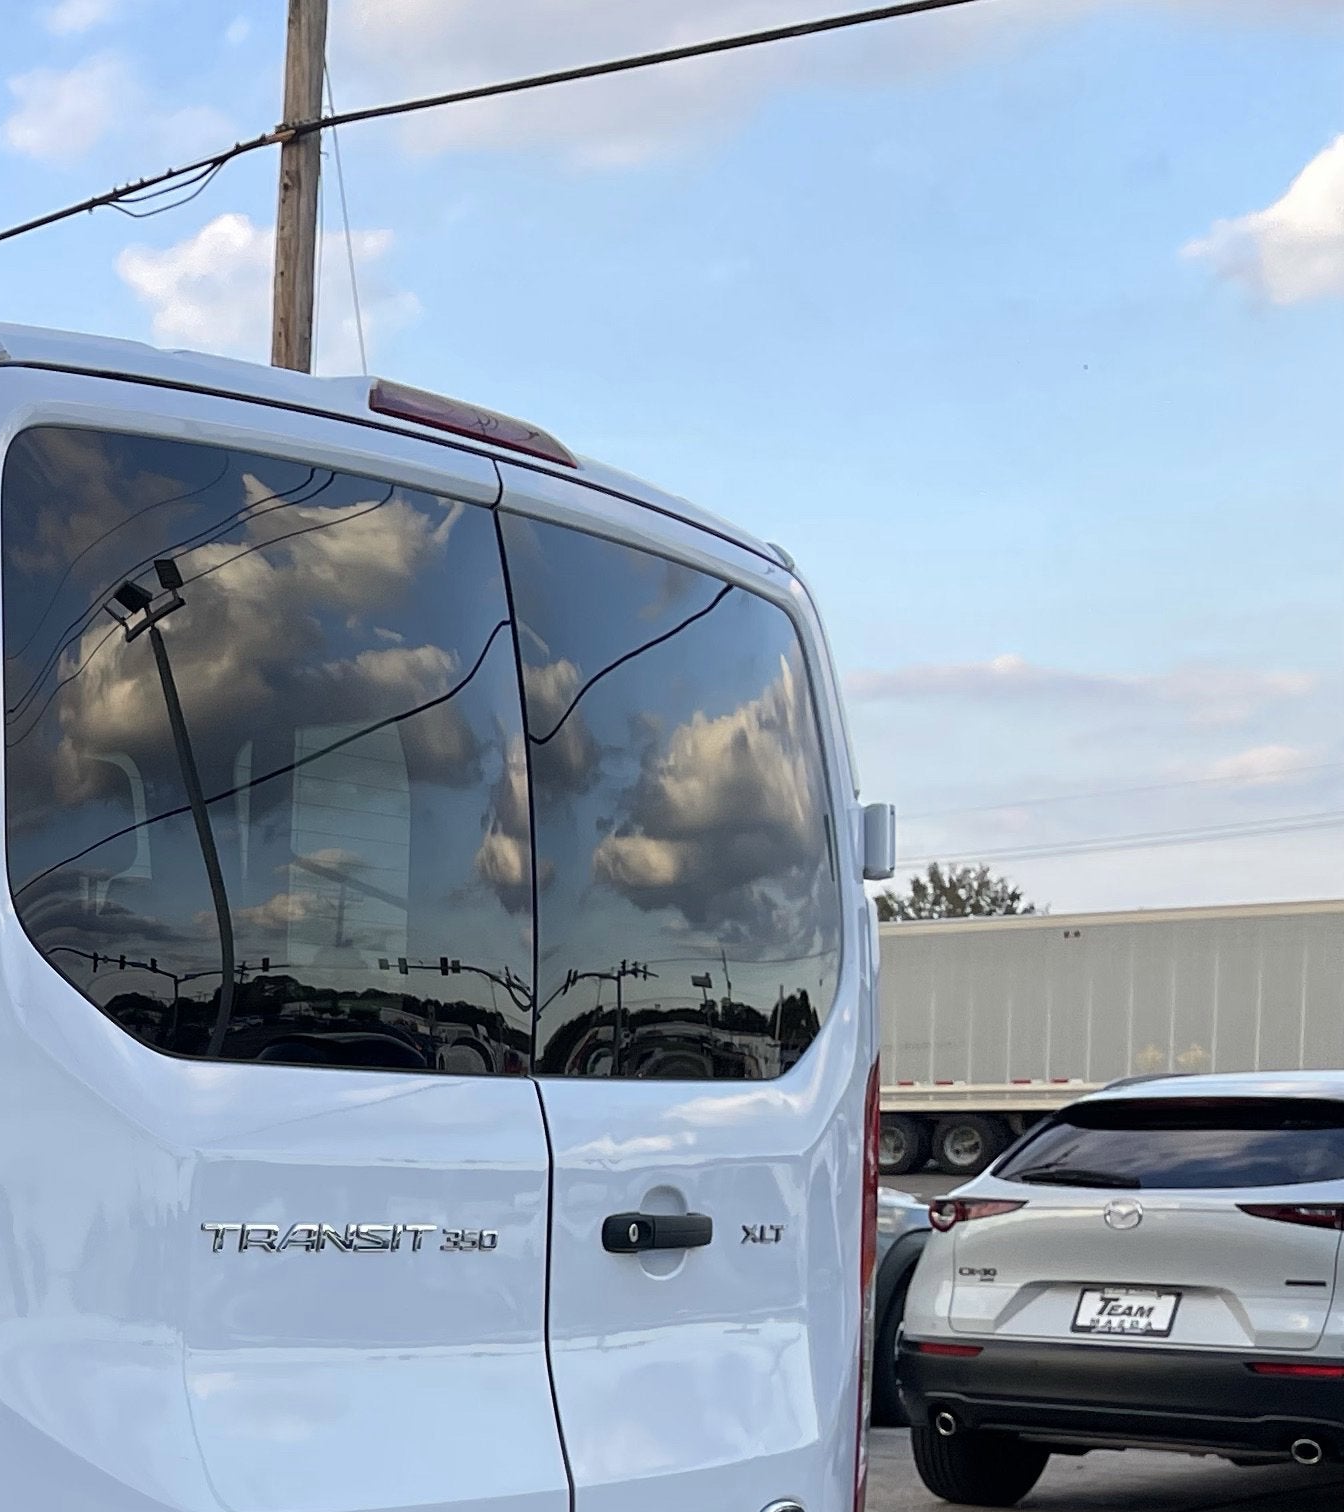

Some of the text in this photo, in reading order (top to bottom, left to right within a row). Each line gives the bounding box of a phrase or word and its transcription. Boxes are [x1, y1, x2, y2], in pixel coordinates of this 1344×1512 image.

[200, 1221, 501, 1253] TRANSIT 350
[740, 1223, 785, 1245] XLT
[1097, 1296, 1154, 1318] TEAM
